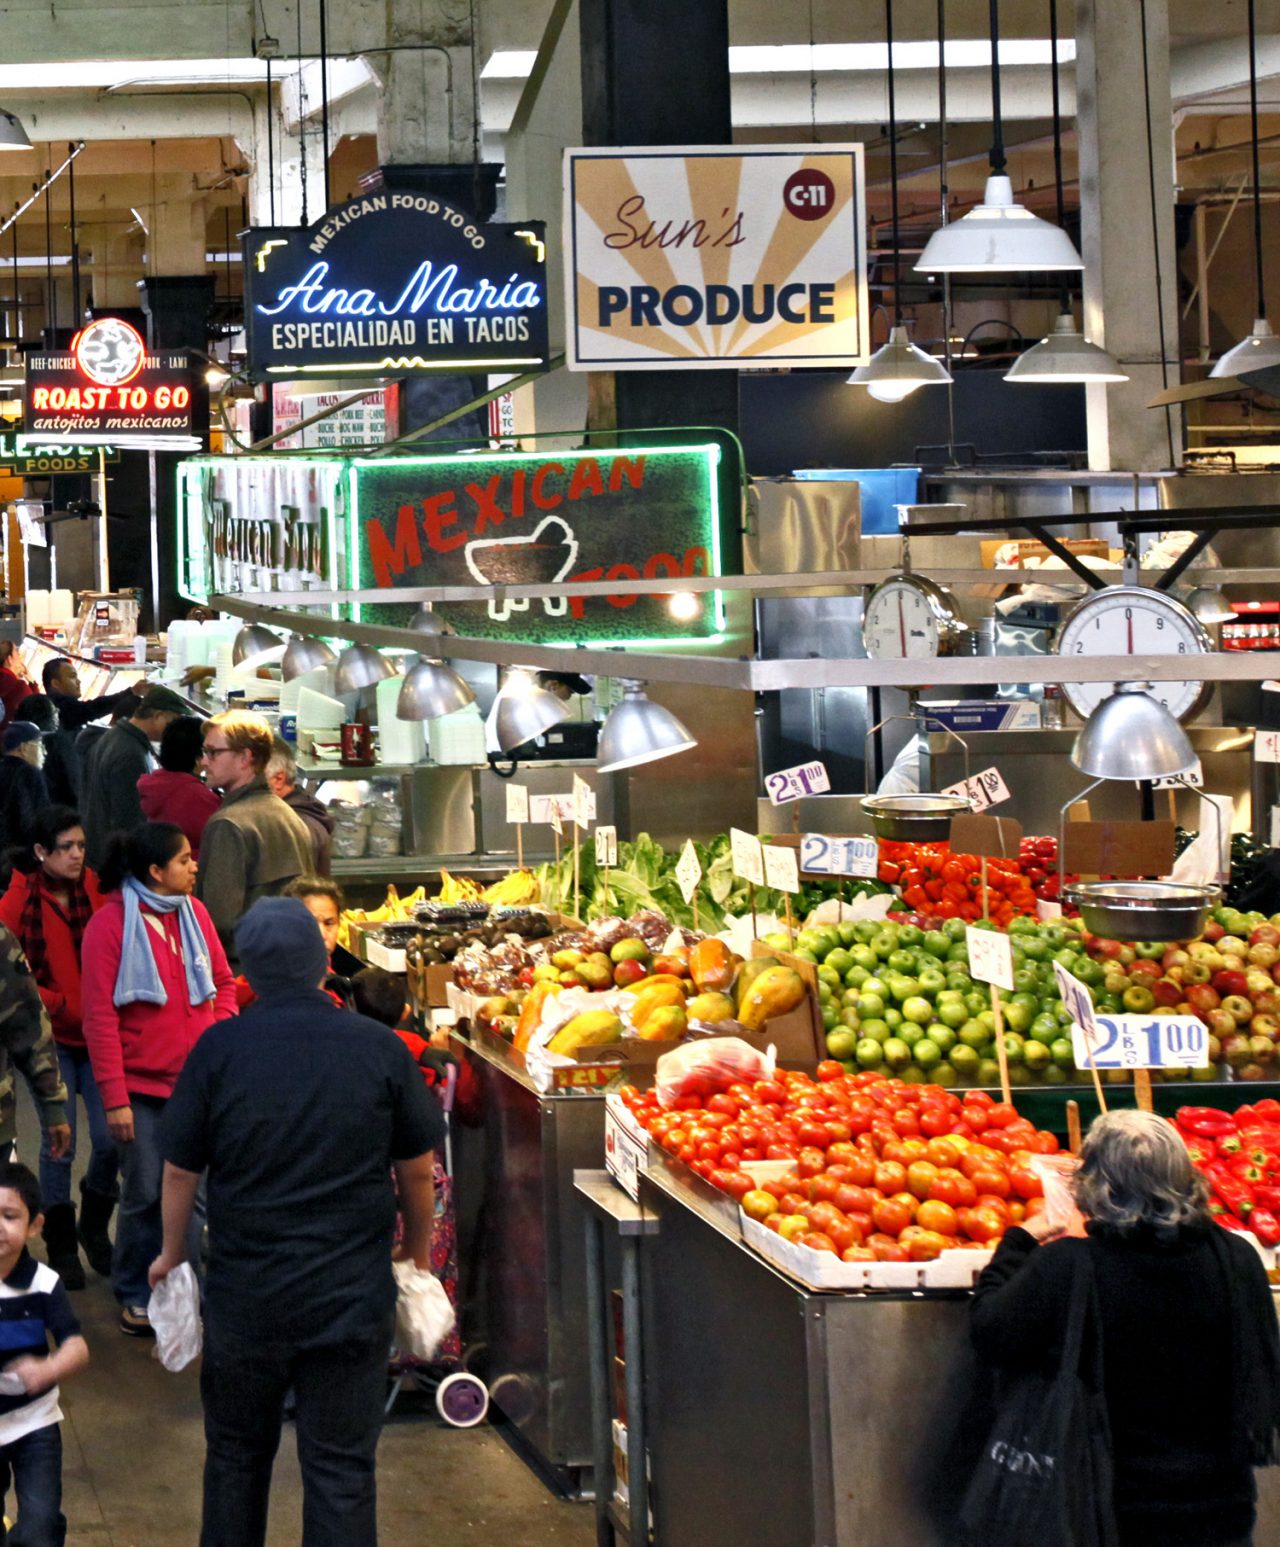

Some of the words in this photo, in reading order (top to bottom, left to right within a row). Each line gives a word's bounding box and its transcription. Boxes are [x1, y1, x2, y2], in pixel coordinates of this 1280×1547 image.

[309, 196, 387, 254] MEXICAN
[392, 195, 440, 215] FOOD
[442, 206, 464, 228] TO
[463, 225, 486, 249] GO
[603, 195, 747, 250] Sun's
[257, 261, 376, 316] Ana
[598, 283, 836, 328] PRODUCE
[272, 319, 416, 350] ESPECIALIDAD
[427, 318, 455, 345] EN
[465, 316, 530, 343] TACOS
[33, 387, 112, 410] ROAST
[118, 387, 148, 410] TO
[154, 386, 189, 409] GO
[33, 414, 100, 434] antojitos
[105, 414, 189, 429] mexicanos
[26, 457, 89, 471] FOODS
[366, 455, 647, 588] MEXICAN
[1157, 618, 1164, 630] 9
[1077, 641, 1083, 654] 2
[1178, 642, 1185, 654] 8
[769, 773, 797, 802] 2
[803, 837, 828, 872] 2
[1082, 1017, 1122, 1068] 2
